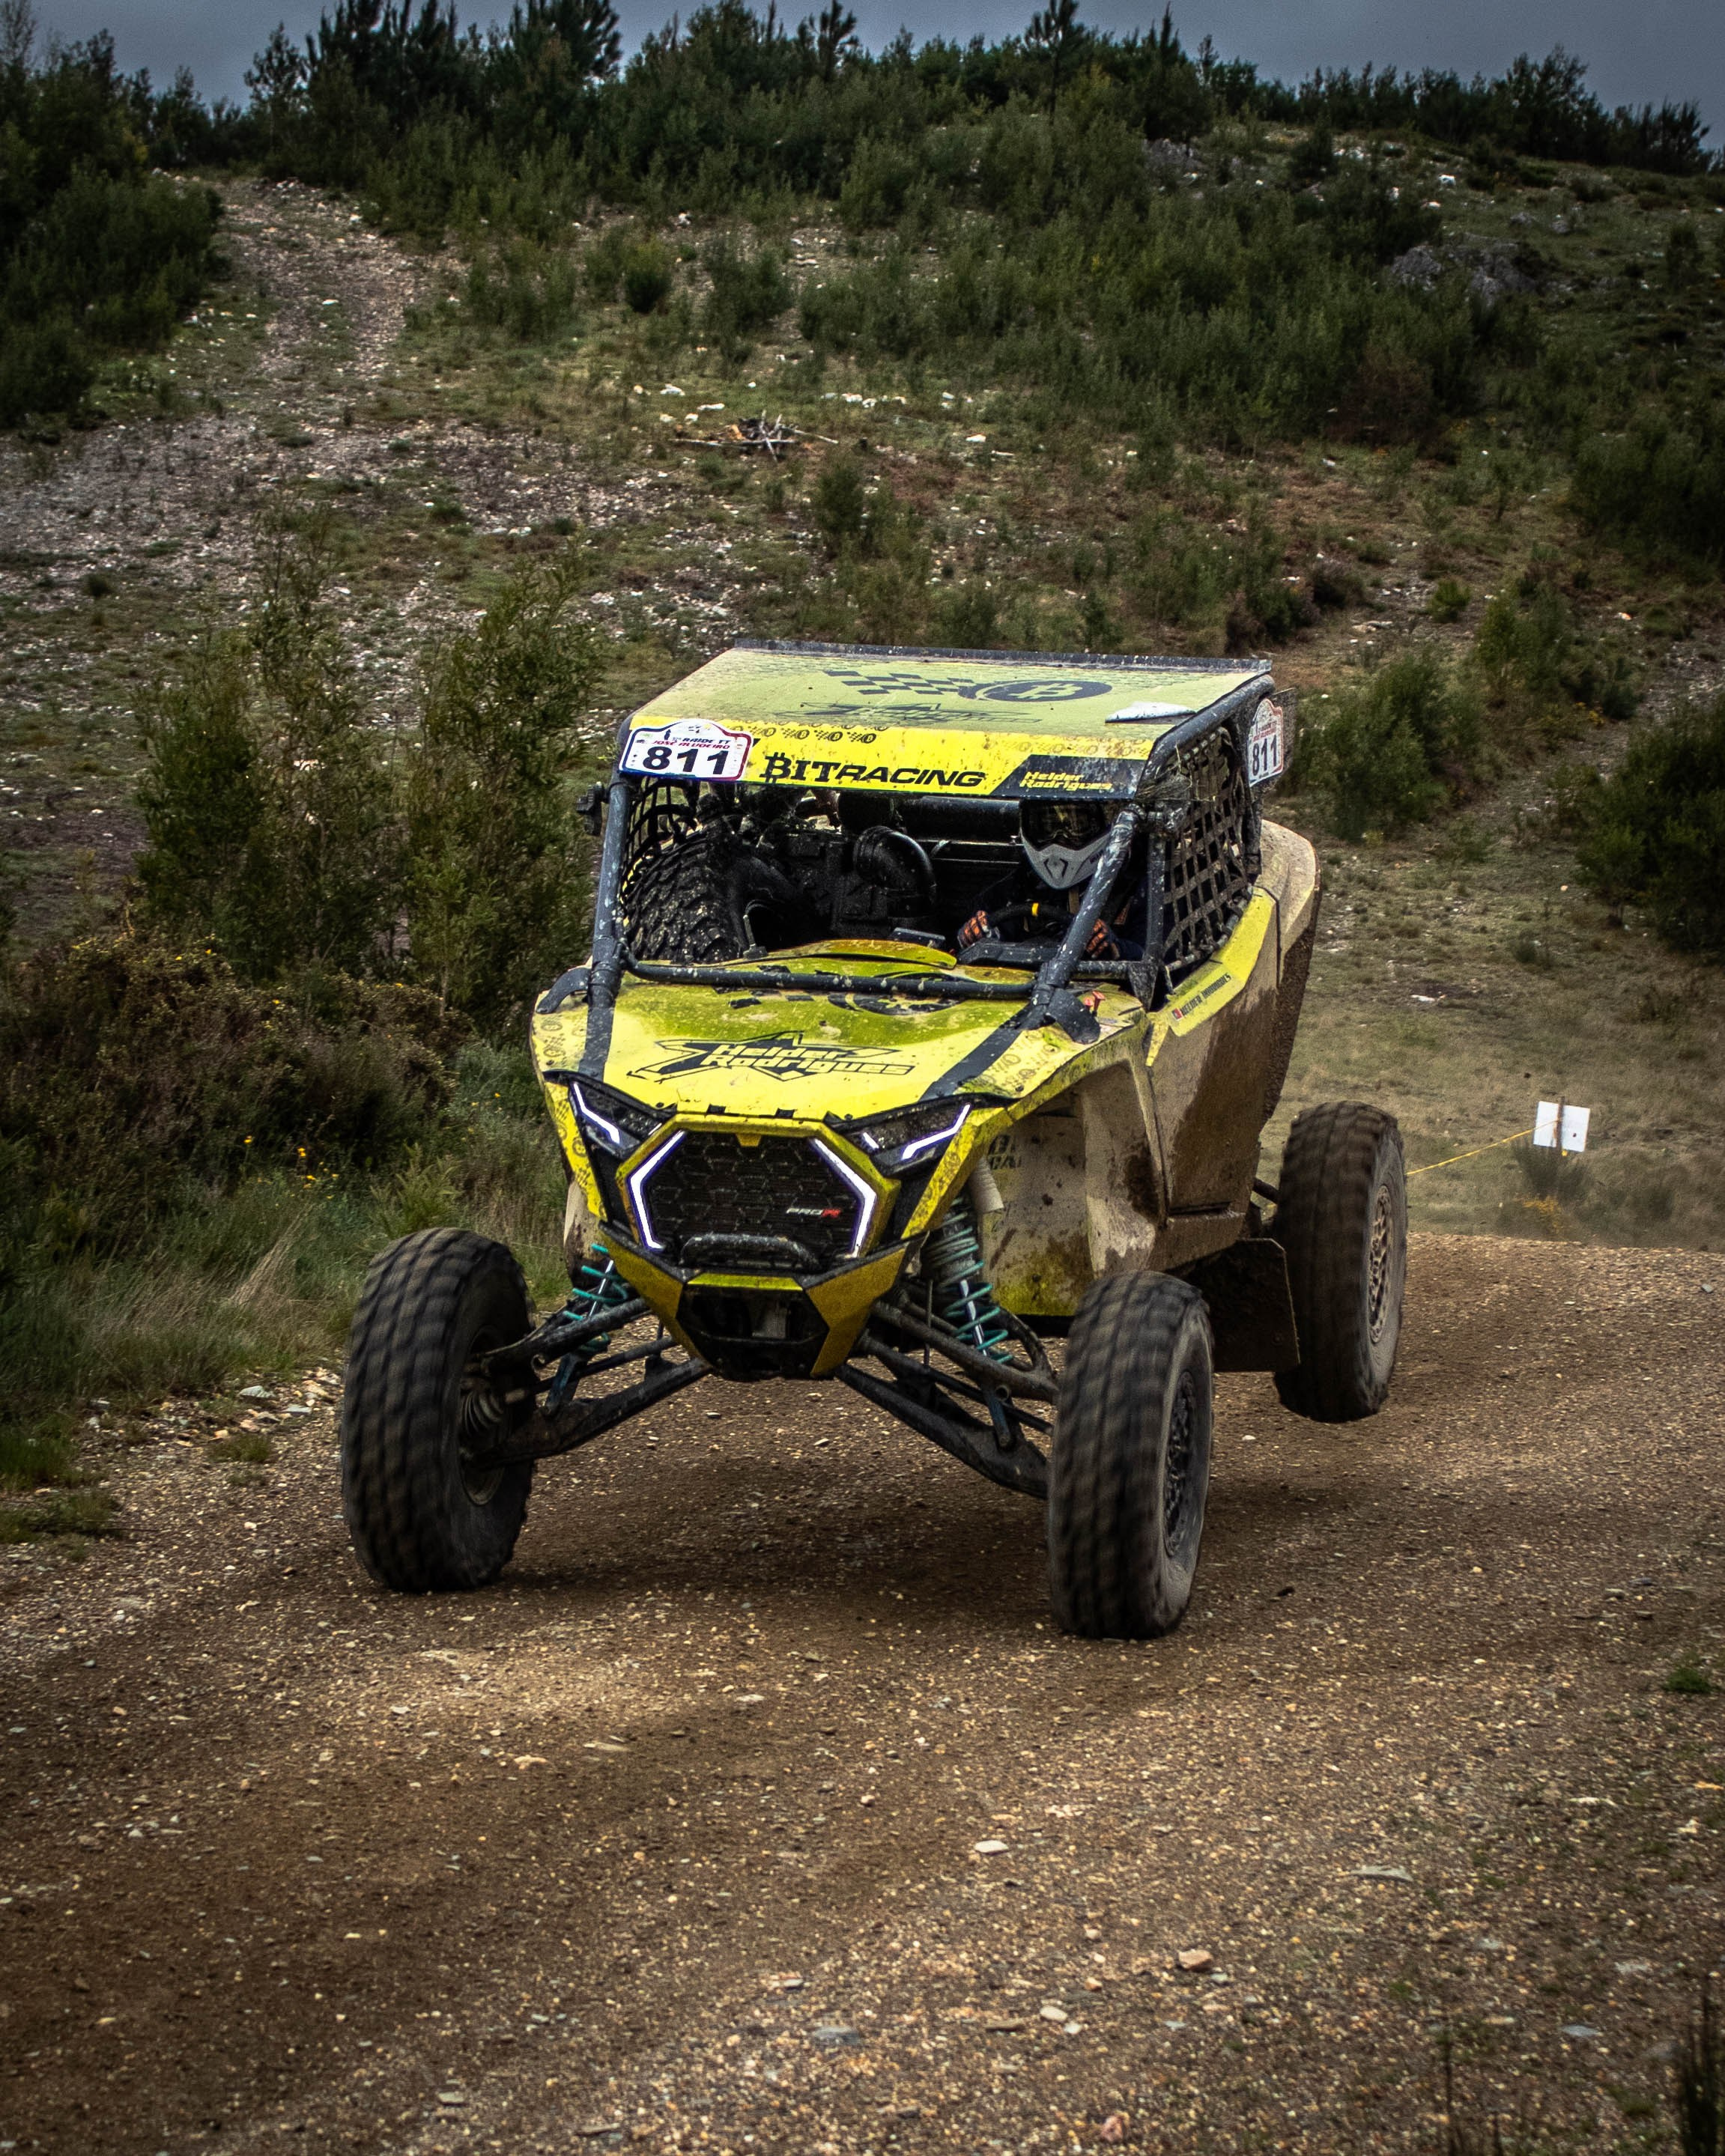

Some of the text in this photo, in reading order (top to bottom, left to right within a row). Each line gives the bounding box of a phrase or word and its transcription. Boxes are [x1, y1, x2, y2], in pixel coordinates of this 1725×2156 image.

[642, 746, 730, 776] 811
[1252, 734, 1277, 777] 811
[759, 752, 986, 787] BITRACING
[1024, 771, 1084, 780] Helder
[1019, 779, 1113, 791] Rodrigues
[713, 1044, 849, 1060] Helder
[700, 1054, 915, 1075] Rodrigues
